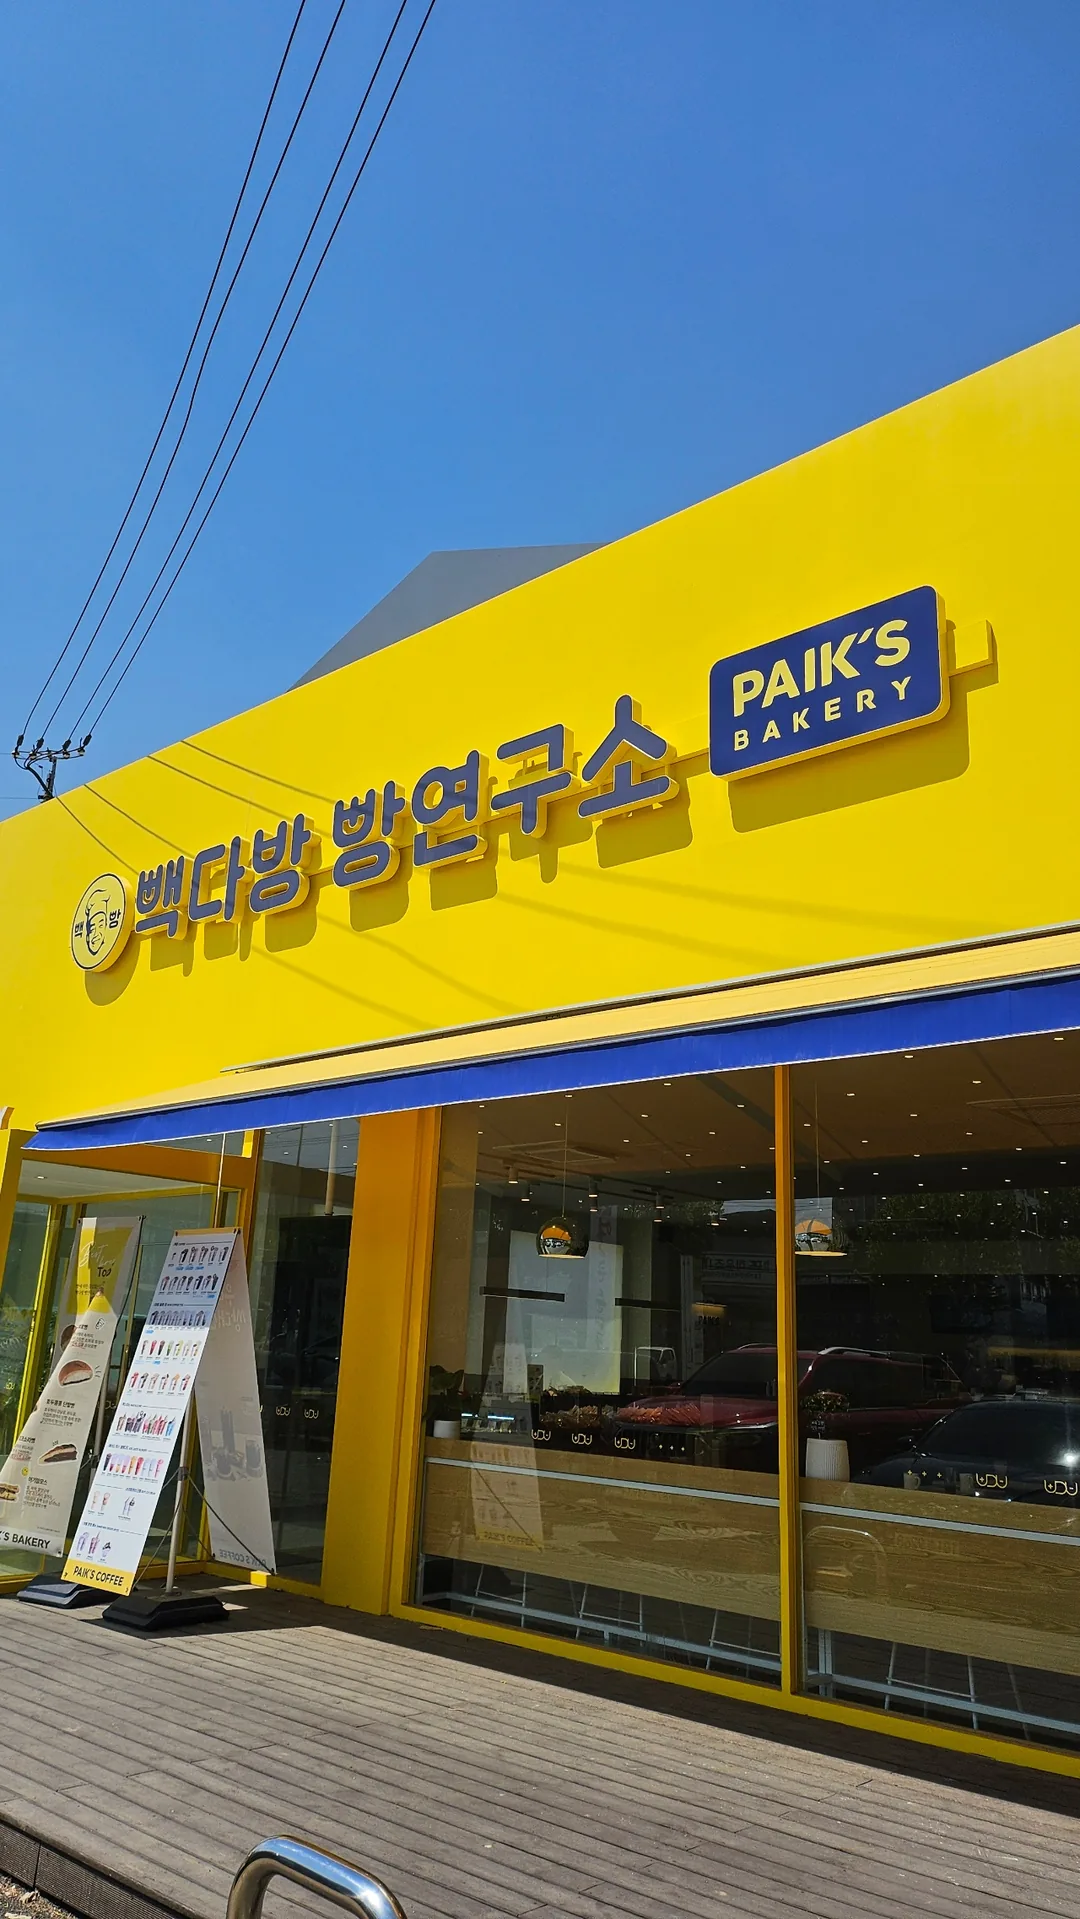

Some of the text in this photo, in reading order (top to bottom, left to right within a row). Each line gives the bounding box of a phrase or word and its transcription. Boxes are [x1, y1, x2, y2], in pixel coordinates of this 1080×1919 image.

[732, 619, 911, 717] PAIK'S
[734, 677, 911, 751] BAKERY
[137, 696, 669, 935] 빽다방 빵연구소
[11, 1533, 51, 1549] BAKERY
[73, 1565, 125, 1587] PAIK'S COFFEE
